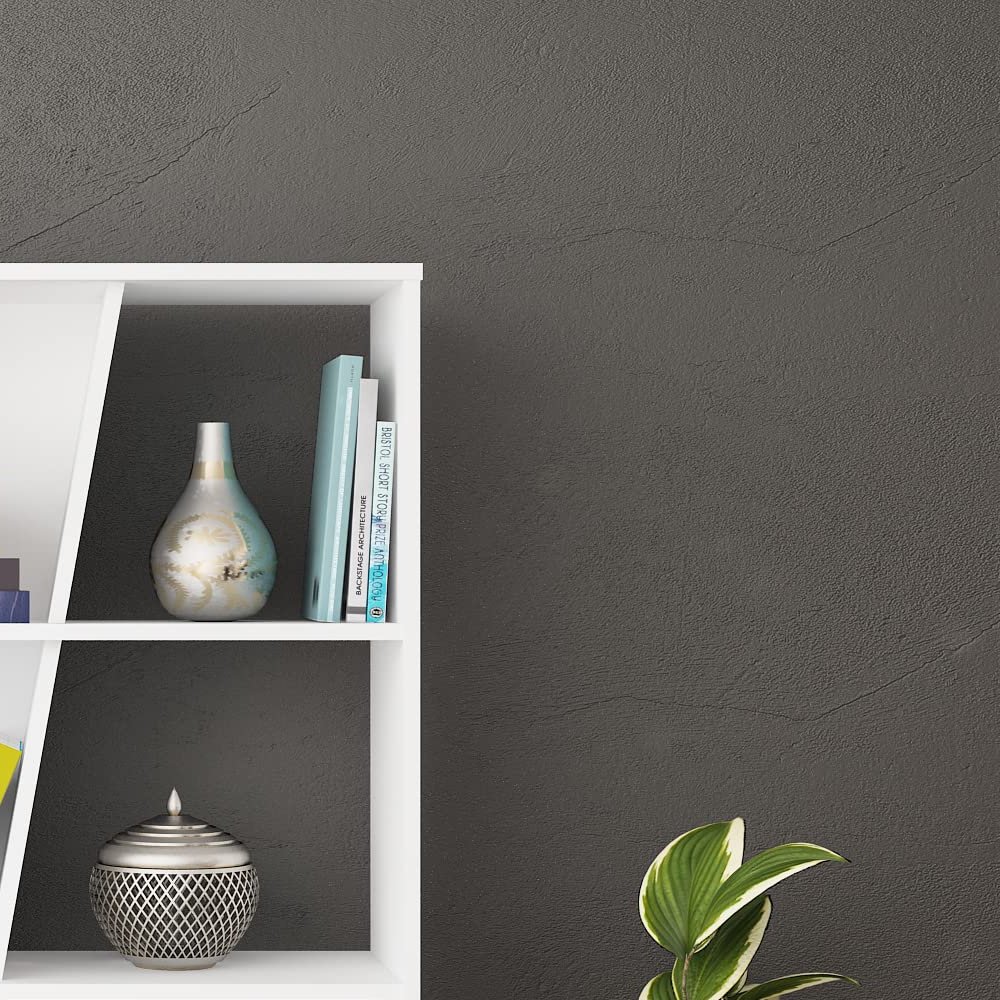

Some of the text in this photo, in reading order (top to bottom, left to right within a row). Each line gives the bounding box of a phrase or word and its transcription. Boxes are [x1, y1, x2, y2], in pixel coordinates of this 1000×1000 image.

[355, 495, 367, 596] BACKSTAGE ARCHITECTURE
[371, 427, 393, 602] BRISTOL SHORT STORY PRIZE ANTHOLOGY
